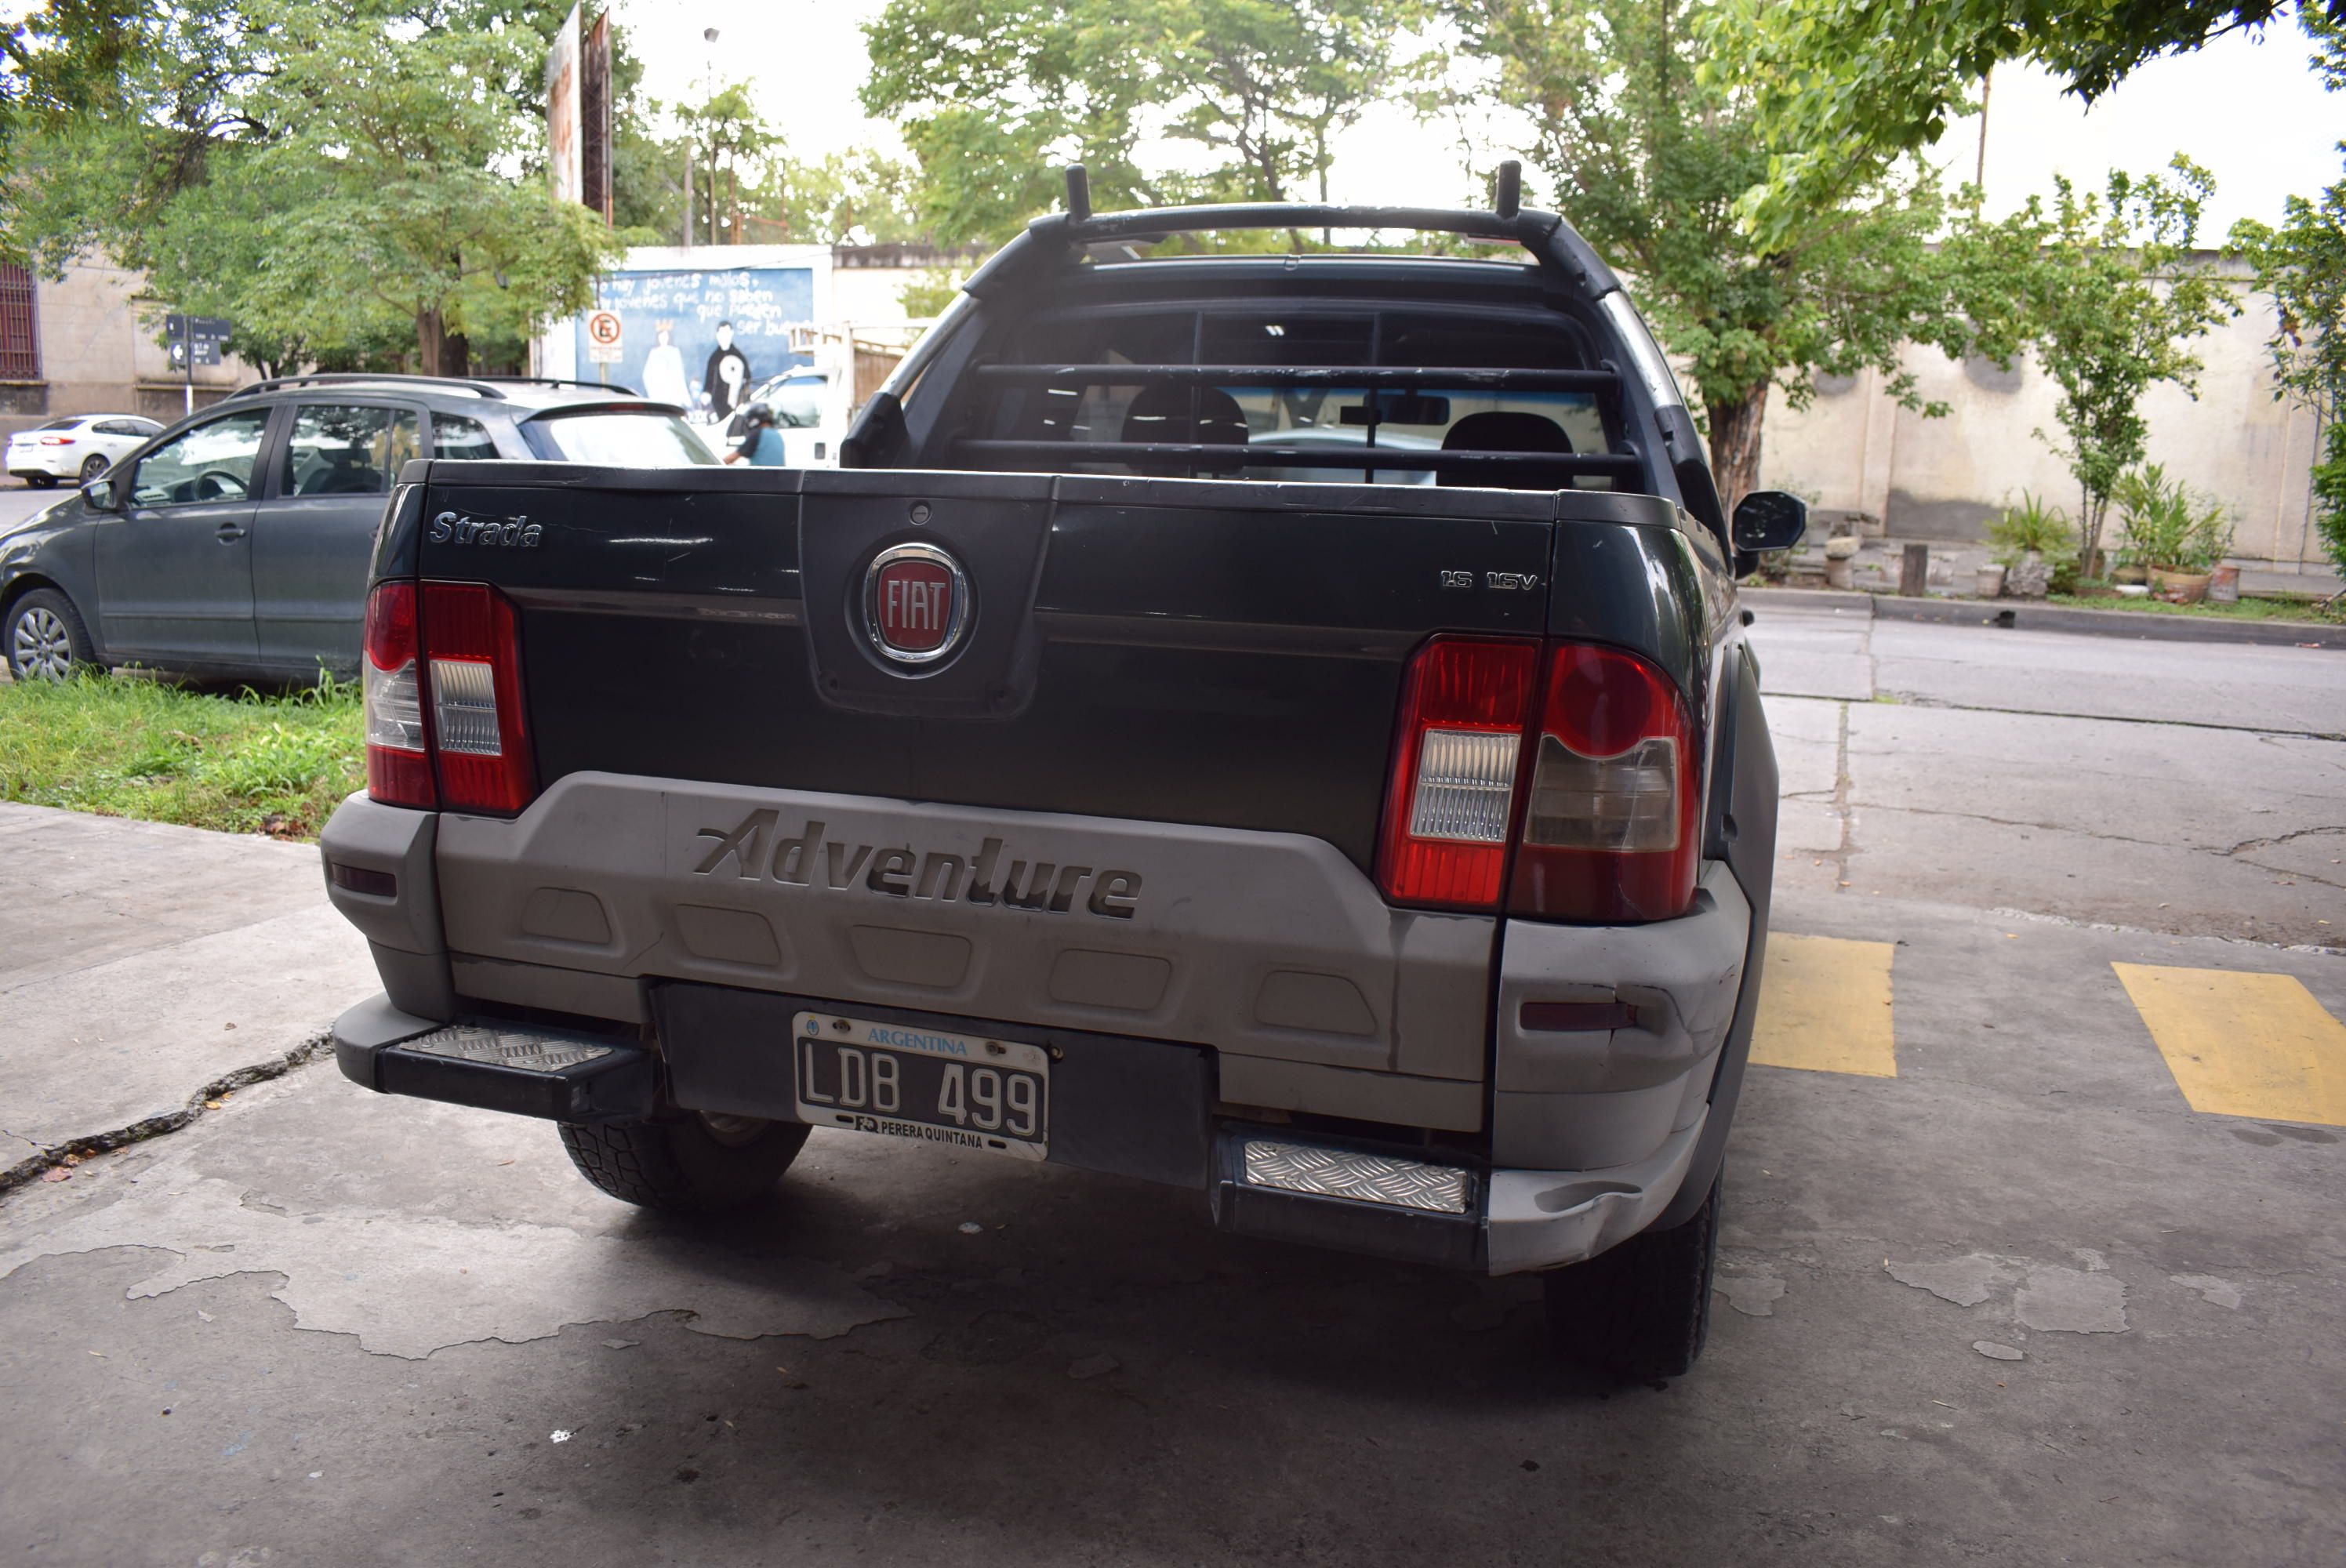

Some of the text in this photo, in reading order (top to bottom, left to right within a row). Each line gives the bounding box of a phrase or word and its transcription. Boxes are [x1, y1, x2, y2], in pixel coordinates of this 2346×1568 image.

[705, 290, 725, 303] no
[696, 304, 723, 325] que
[736, 319, 762, 336] ser
[430, 511, 544, 547] Strada
[1487, 572, 1538, 590] 16V
[888, 579, 946, 630] FIAT
[693, 808, 1142, 920] Adventure
[867, 1028, 968, 1056] ARGENTINA
[805, 1043, 1037, 1137] LDB 499
[881, 1121, 924, 1139] PERERA
[924, 1127, 983, 1149] QUINTANA
